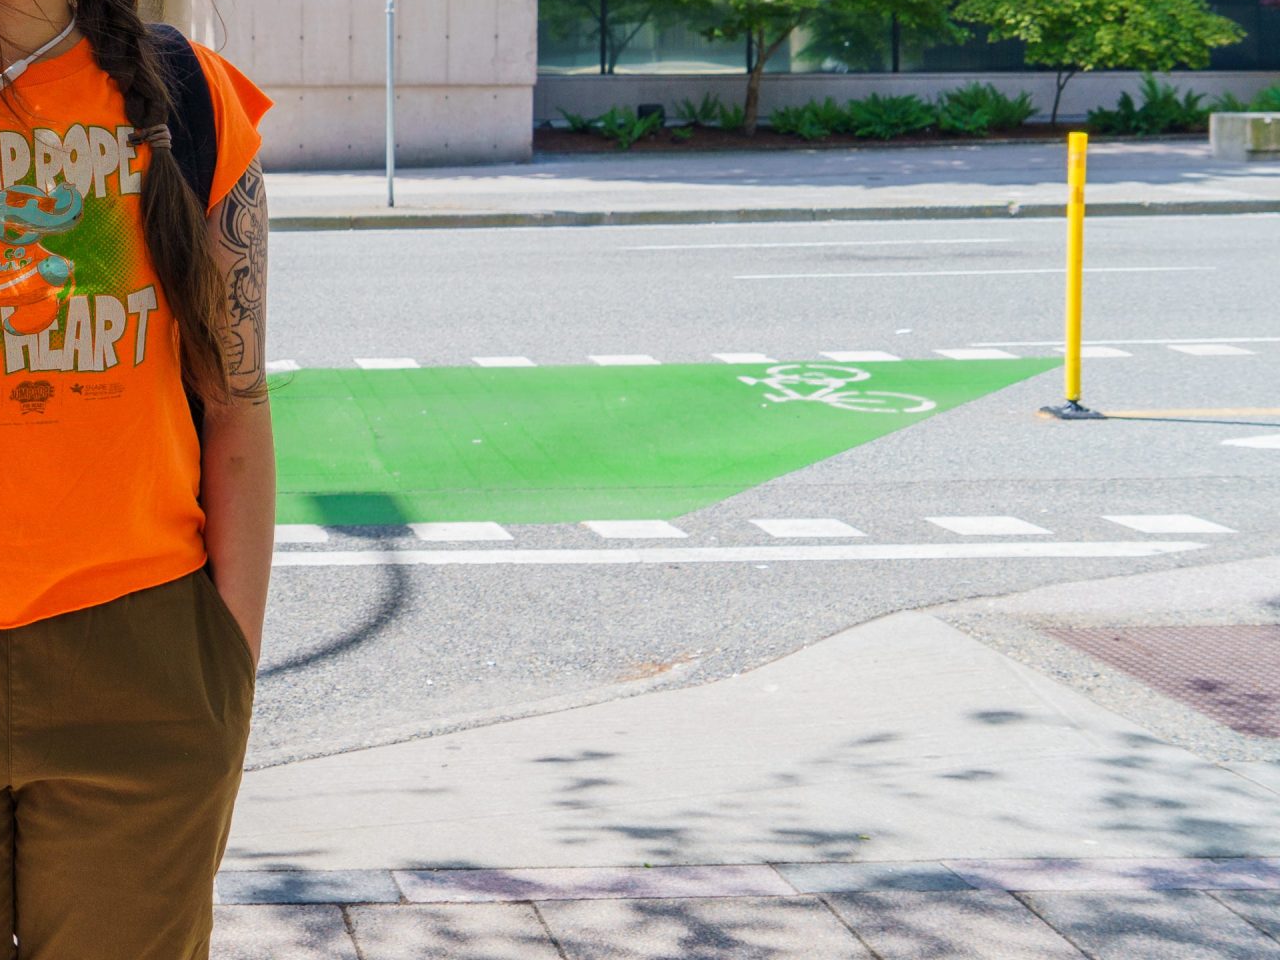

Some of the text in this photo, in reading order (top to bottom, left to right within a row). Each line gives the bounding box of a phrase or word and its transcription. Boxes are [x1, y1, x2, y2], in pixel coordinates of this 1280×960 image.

[33, 124, 142, 199] ROPE
[4, 247, 25, 259] GO
[0, 285, 158, 375] HEART
